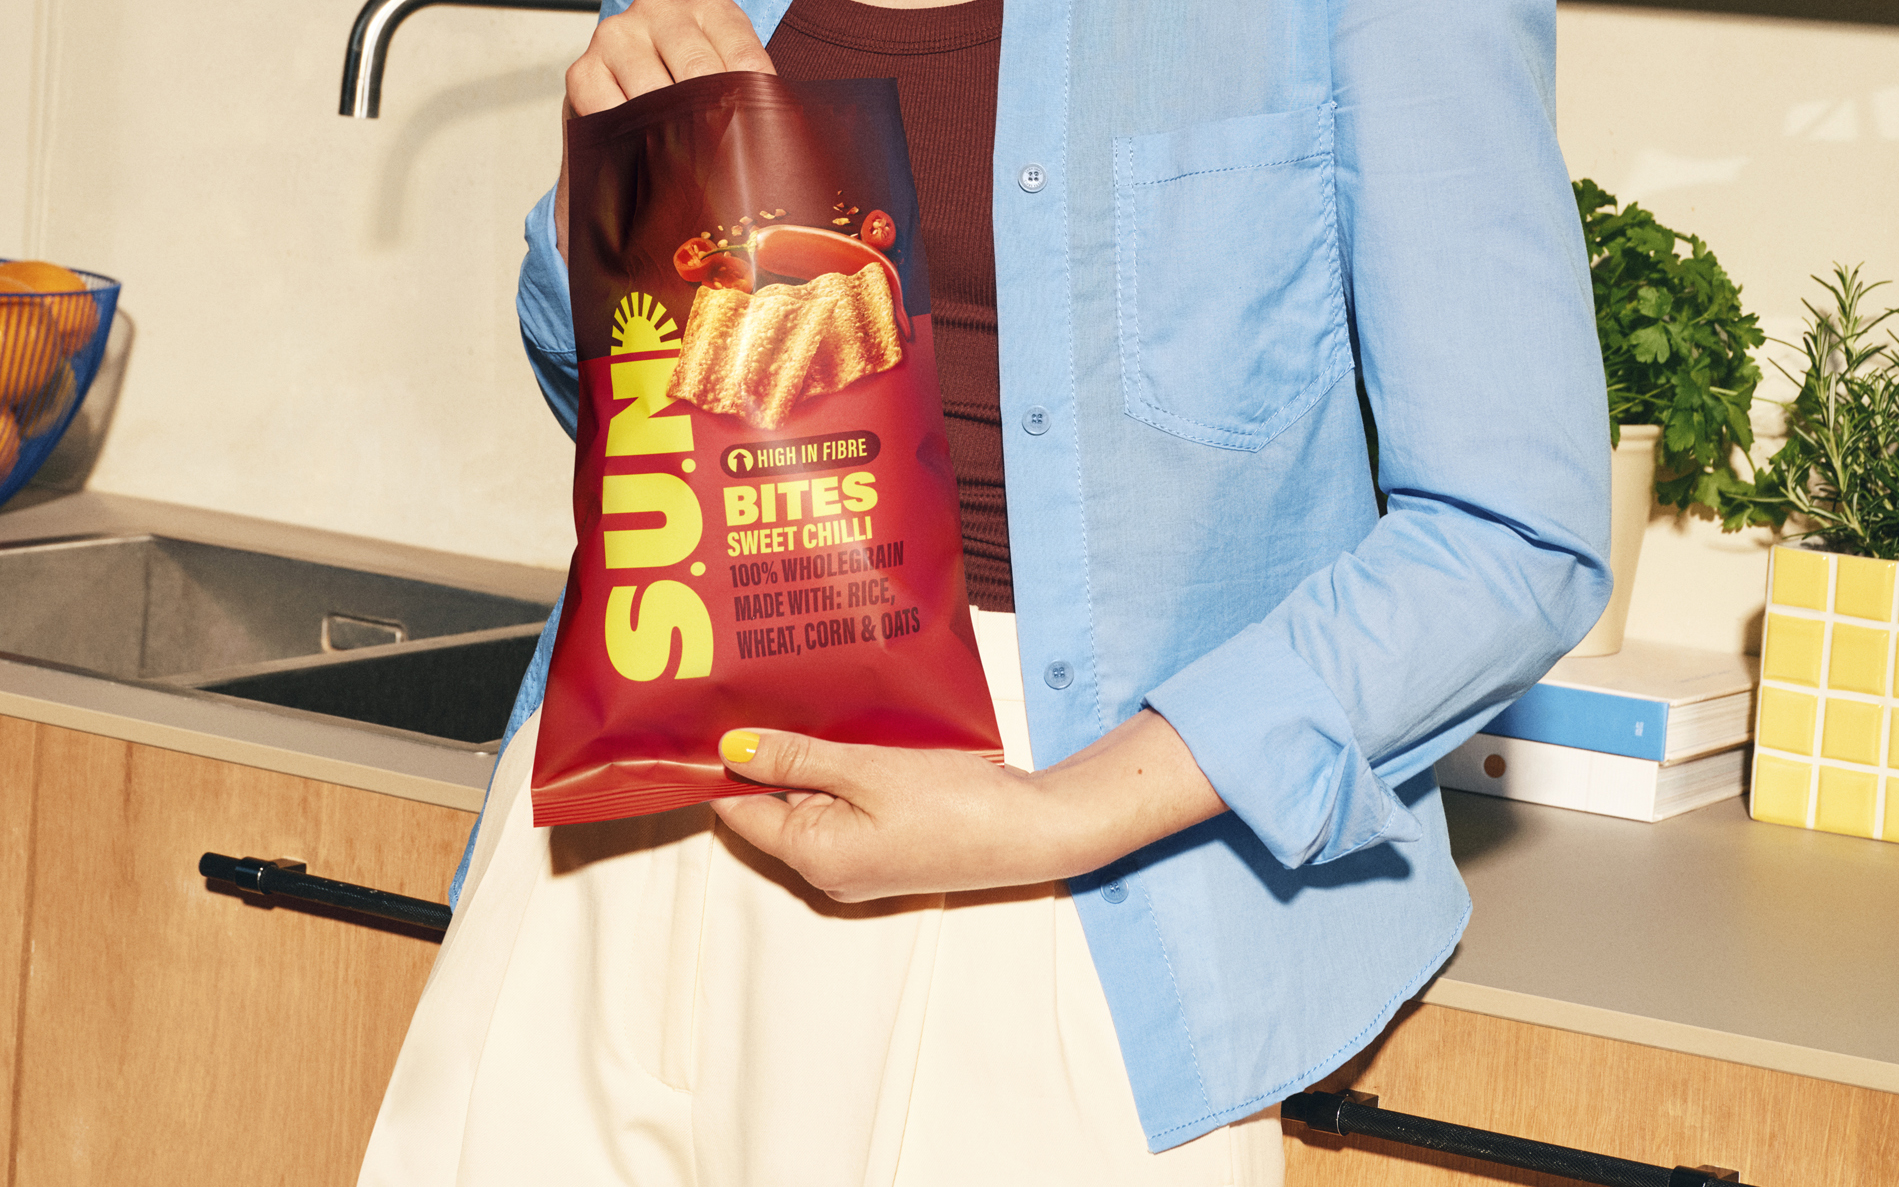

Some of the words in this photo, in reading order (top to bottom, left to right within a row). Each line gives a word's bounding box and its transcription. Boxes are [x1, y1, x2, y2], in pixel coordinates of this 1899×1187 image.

[757, 446, 796, 468] HIGH
[801, 443, 818, 463] IN
[823, 438, 867, 461] FIBRE
[723, 471, 878, 526] BITES
[727, 526, 797, 557] SWEET
[802, 516, 872, 549] CHILLI
[729, 561, 778, 588] 100%
[781, 541, 904, 583] WHOLEGRAIN
[734, 592, 784, 621] MADE
[787, 585, 842, 616] WITH:
[848, 577, 895, 608] RICE,
[736, 625, 801, 659] WHEAT,
[804, 617, 856, 650] CORN
[861, 615, 877, 643] &
[881, 606, 920, 640] OATS
